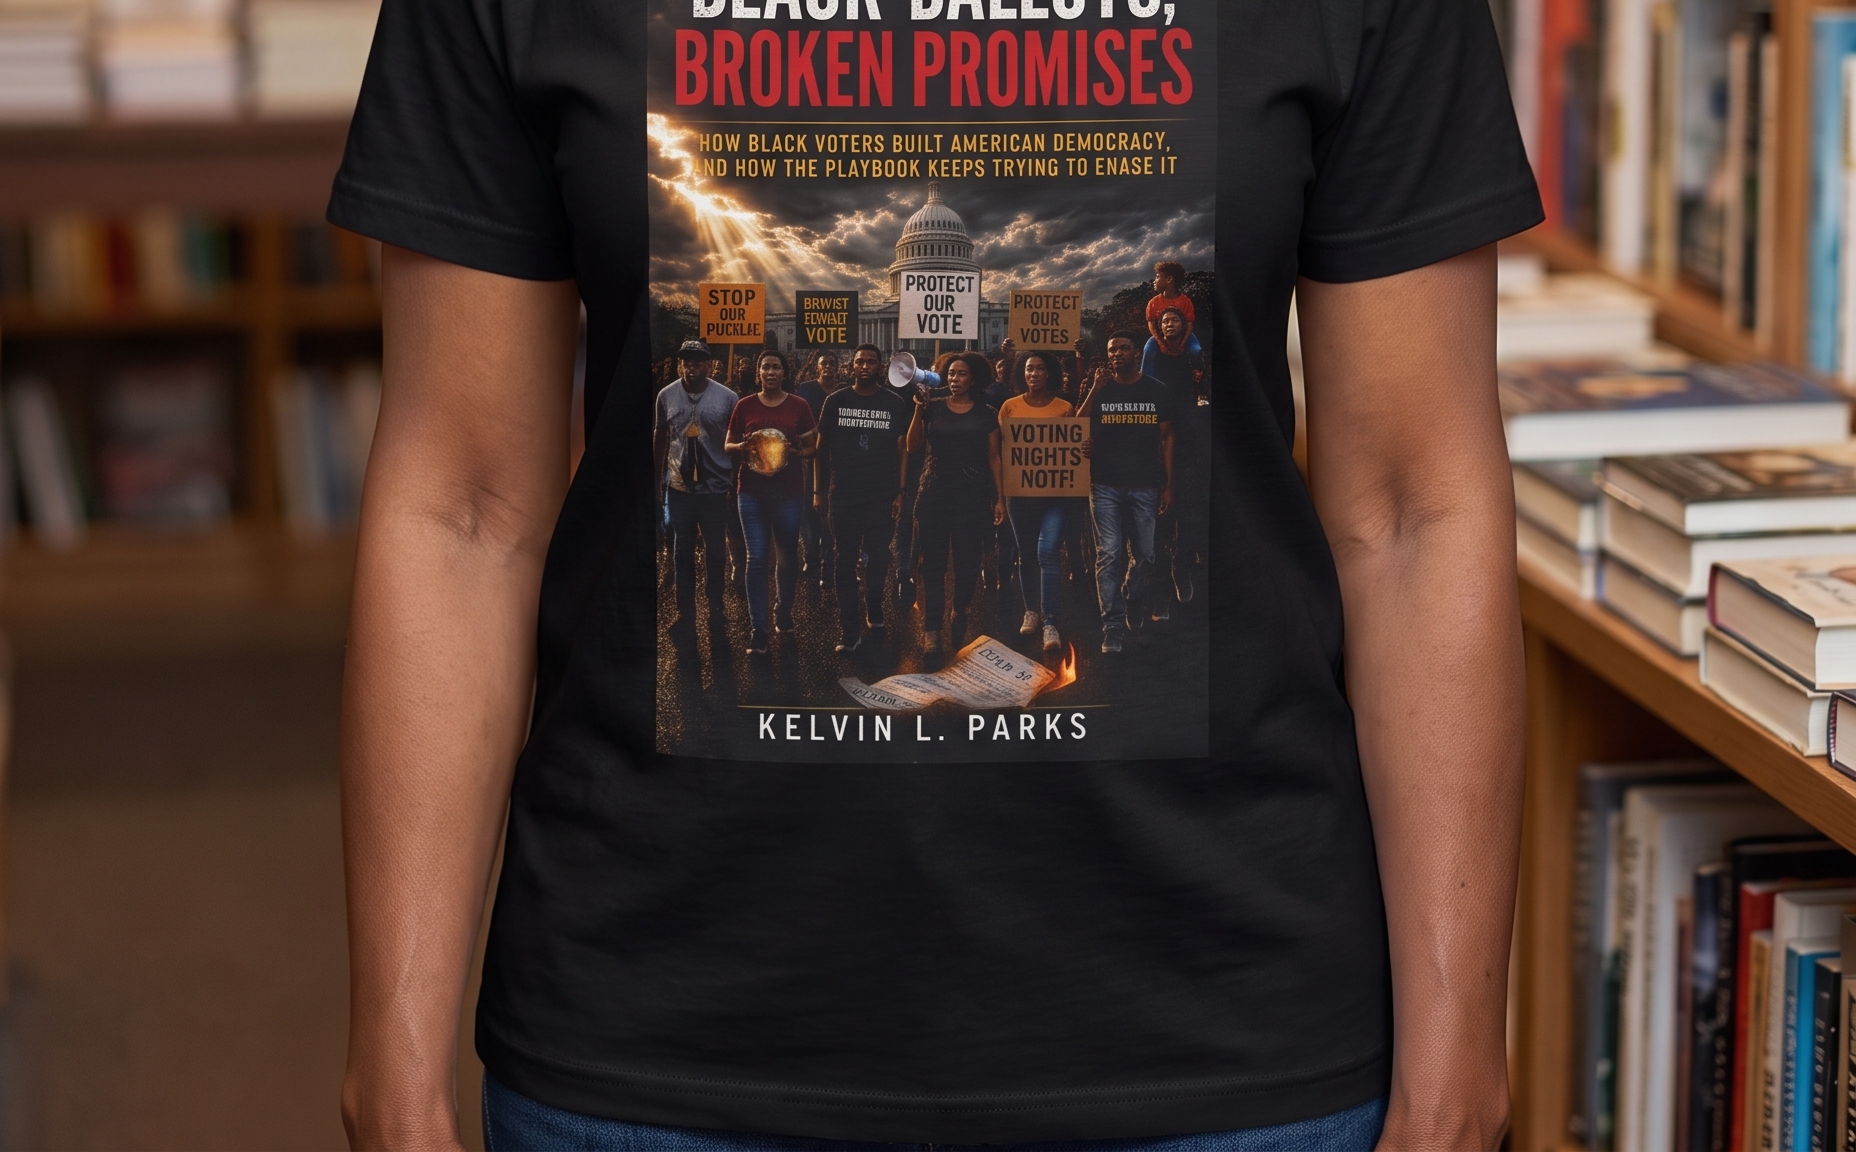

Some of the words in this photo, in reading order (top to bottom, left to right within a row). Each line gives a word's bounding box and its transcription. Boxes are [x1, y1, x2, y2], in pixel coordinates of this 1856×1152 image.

[675, 28, 893, 108] BROKEN
[913, 28, 1193, 108] PROMISES
[699, 133, 741, 153] HOW
[748, 133, 807, 153] BLACK
[815, 134, 885, 153] VOTERS
[892, 134, 943, 153] BUILT
[950, 133, 1045, 153] AMERICAN
[1053, 132, 1171, 153] DEMOCRACY,
[735, 158, 776, 177] HOW
[783, 159, 818, 178] THE
[825, 159, 920, 178] PLAYBOOK
[928, 159, 985, 178] KEEPS
[992, 158, 1059, 177] TRYING
[1066, 158, 1088, 177] TO
[1095, 156, 1153, 176] ENASE
[1161, 156, 1177, 175] IT
[905, 274, 975, 293] PROTECT
[708, 289, 756, 306] STOP
[923, 294, 955, 312] OUR
[1014, 294, 1080, 311] PROTECT
[719, 308, 746, 321] OUR
[1030, 311, 1060, 326] OUR
[917, 313, 963, 335] VOTE
[806, 327, 847, 344] VOTE
[1020, 328, 1069, 344] VOTES
[1010, 424, 1083, 444] VOTING
[759, 712, 891, 742] KELVIN
[916, 714, 945, 742] L.
[968, 712, 1087, 741] PARKS
